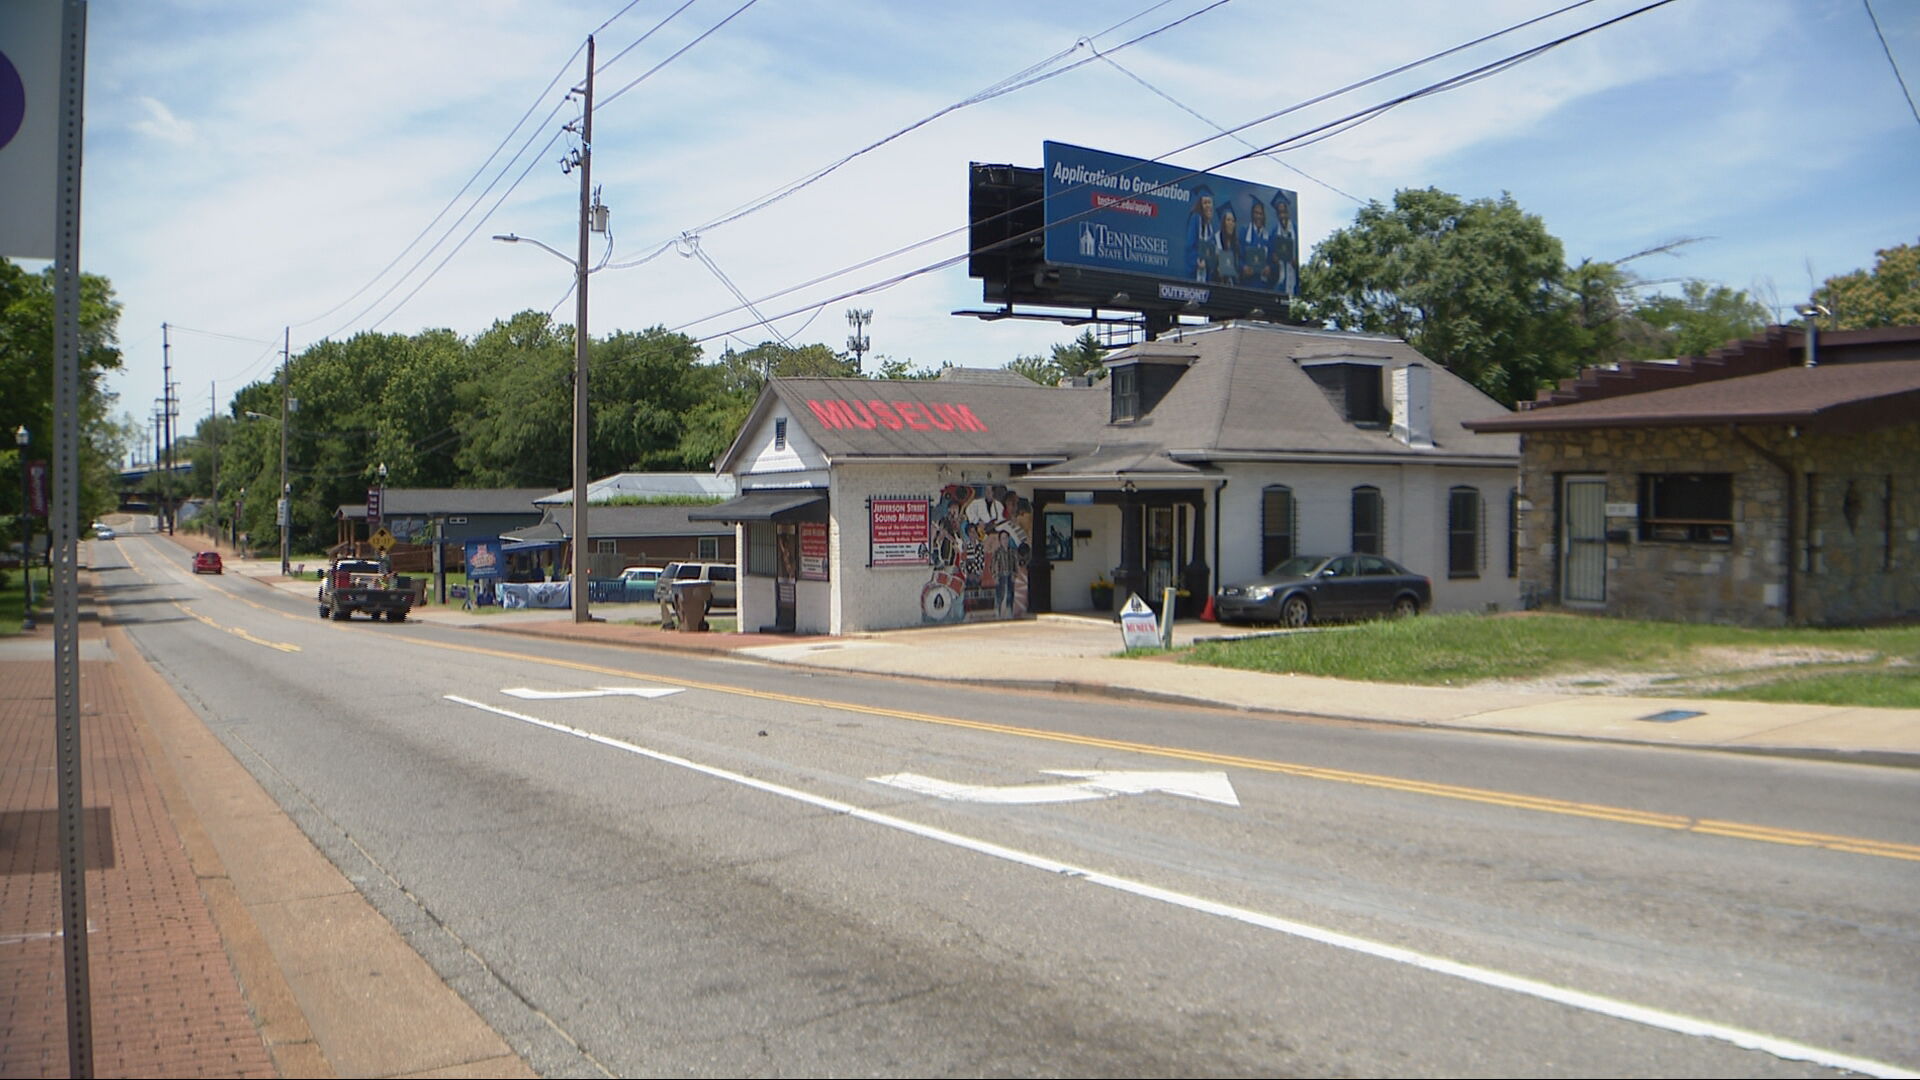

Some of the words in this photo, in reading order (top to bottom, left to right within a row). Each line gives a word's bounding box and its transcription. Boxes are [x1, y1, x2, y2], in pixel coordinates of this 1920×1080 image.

[1053, 161, 1117, 188] Application
[1119, 175, 1131, 191] to
[1132, 176, 1190, 202] Graduation
[1096, 224, 1168, 255] TENNESSEE
[1097, 244, 1123, 260] STATE
[1123, 246, 1169, 267] UNIVERSITY
[807, 400, 988, 433] MUSEUM
[873, 503, 906, 513] JEFFERSON
[907, 503, 926, 513] STREET
[874, 513, 897, 523] SOUND
[898, 513, 926, 522] MUSEUM
